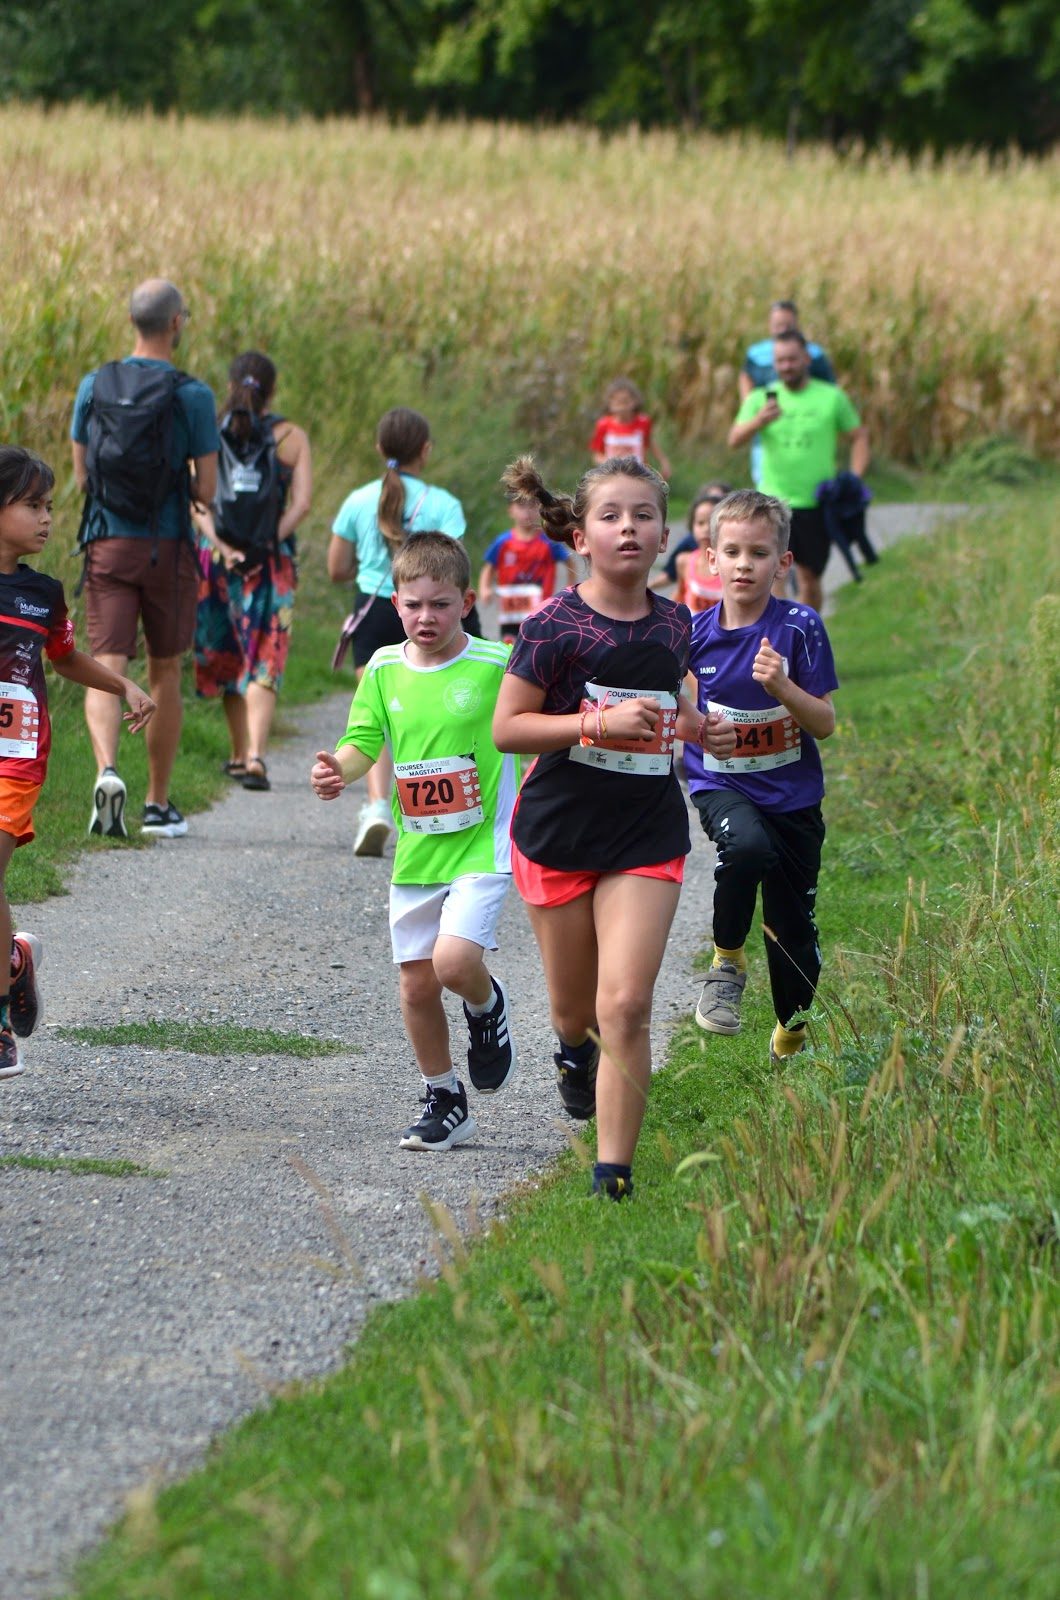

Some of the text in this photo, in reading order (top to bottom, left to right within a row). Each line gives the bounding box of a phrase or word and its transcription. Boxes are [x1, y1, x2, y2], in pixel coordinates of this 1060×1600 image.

[20, 602, 50, 614] Mulhouse
[607, 690, 638, 699] COURSES
[722, 709, 749, 718] COURSES
[396, 763, 424, 772] COURSES
[409, 767, 443, 777] MAGSTATT
[406, 778, 455, 807] 720
